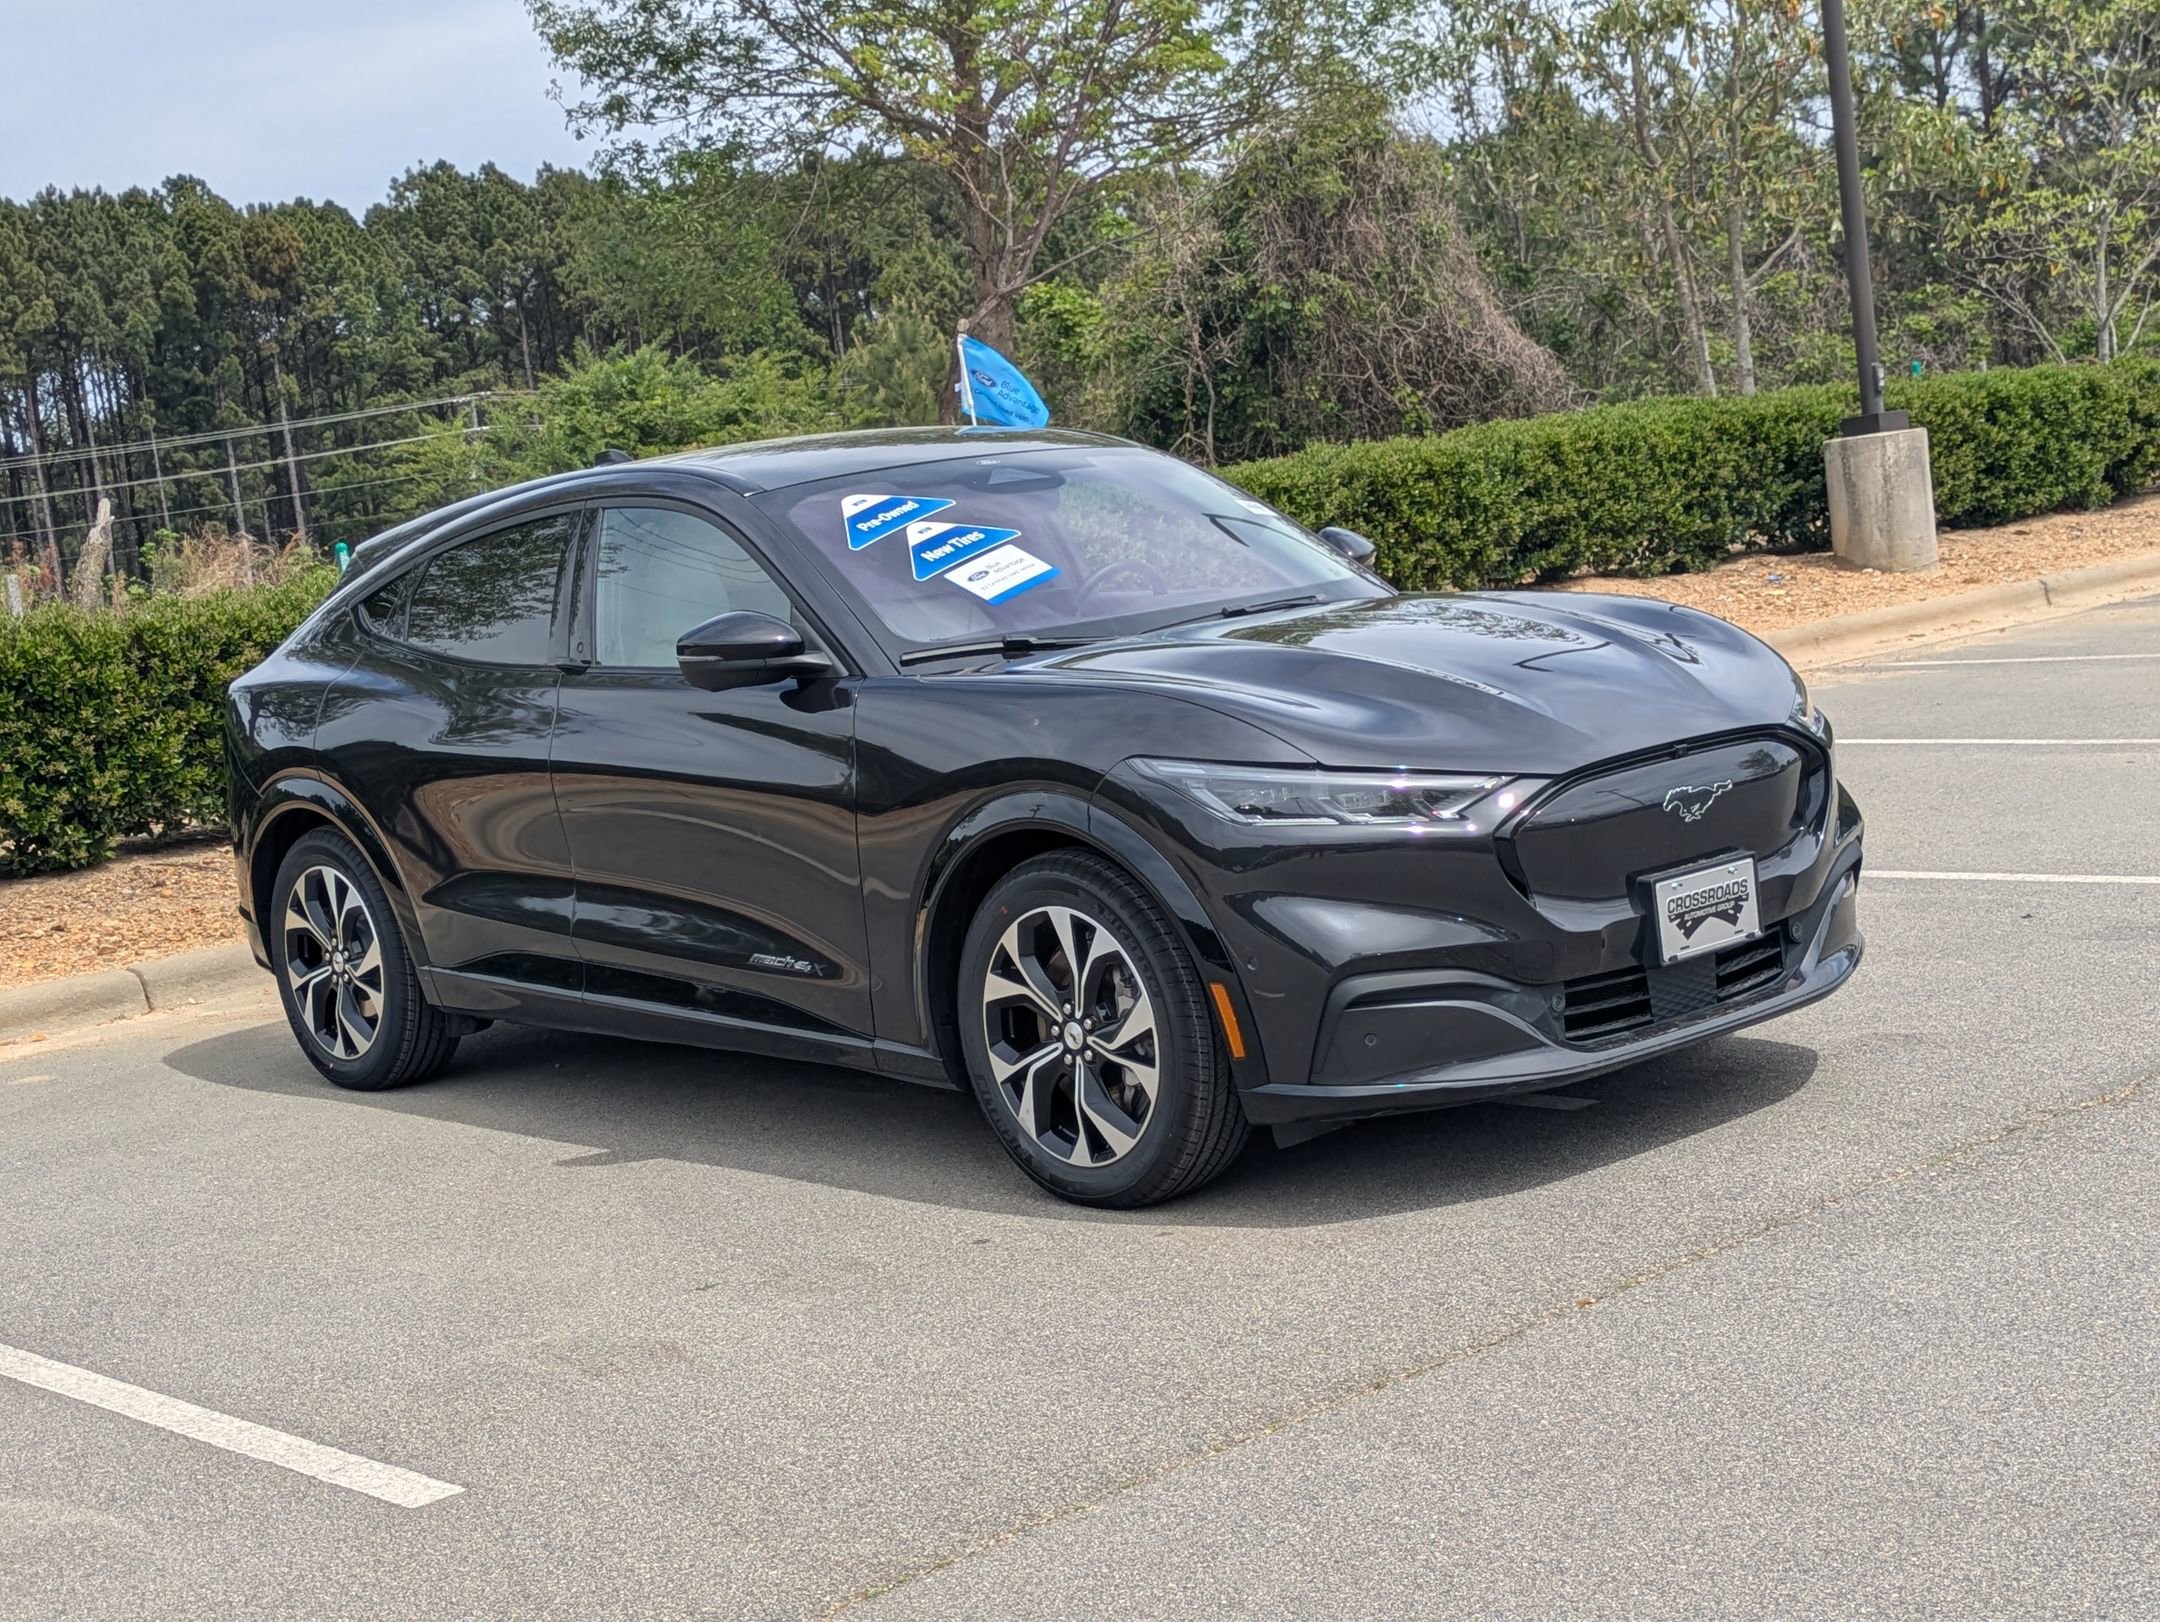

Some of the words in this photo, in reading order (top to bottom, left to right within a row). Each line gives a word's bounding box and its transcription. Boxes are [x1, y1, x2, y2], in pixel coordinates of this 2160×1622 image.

[1000, 380, 1020, 395] Blue
[997, 390, 1041, 415] Advantage
[856, 500, 920, 532] Pre-Owned
[920, 543, 955, 562] New
[947, 531, 986, 548] Tires
[1666, 878, 1749, 914] CROSSROADS
[1683, 905, 1717, 921] AUTOMOTIVE
[1716, 901, 1736, 912] GROUP
